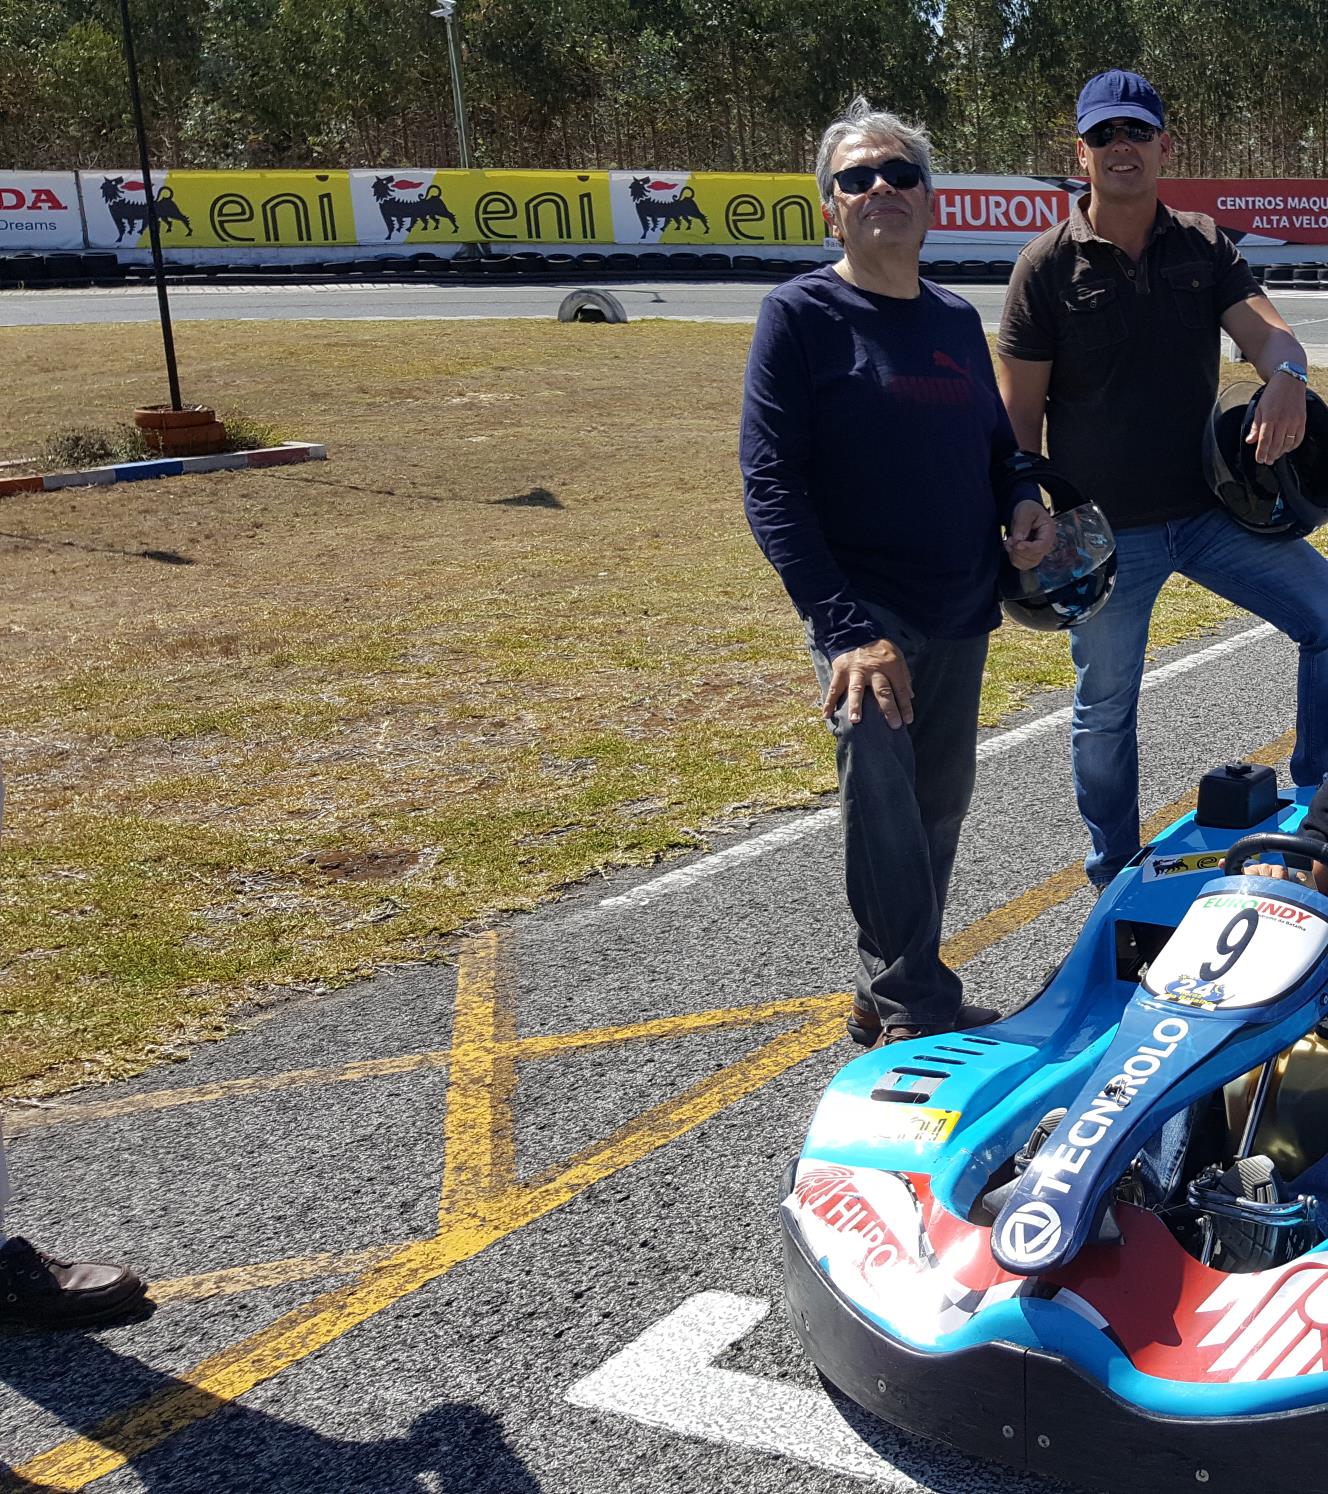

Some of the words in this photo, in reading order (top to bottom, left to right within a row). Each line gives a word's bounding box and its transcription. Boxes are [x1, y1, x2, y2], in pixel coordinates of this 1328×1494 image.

[210, 174, 338, 243] eni
[474, 174, 597, 241] eni
[724, 192, 830, 242] en
[939, 194, 1060, 229] HURON
[1217, 196, 1285, 212] CENTROS
[1252, 215, 1288, 230] ALTA
[1202, 897, 1313, 924] EUROINDY
[1199, 907, 1260, 982] 9
